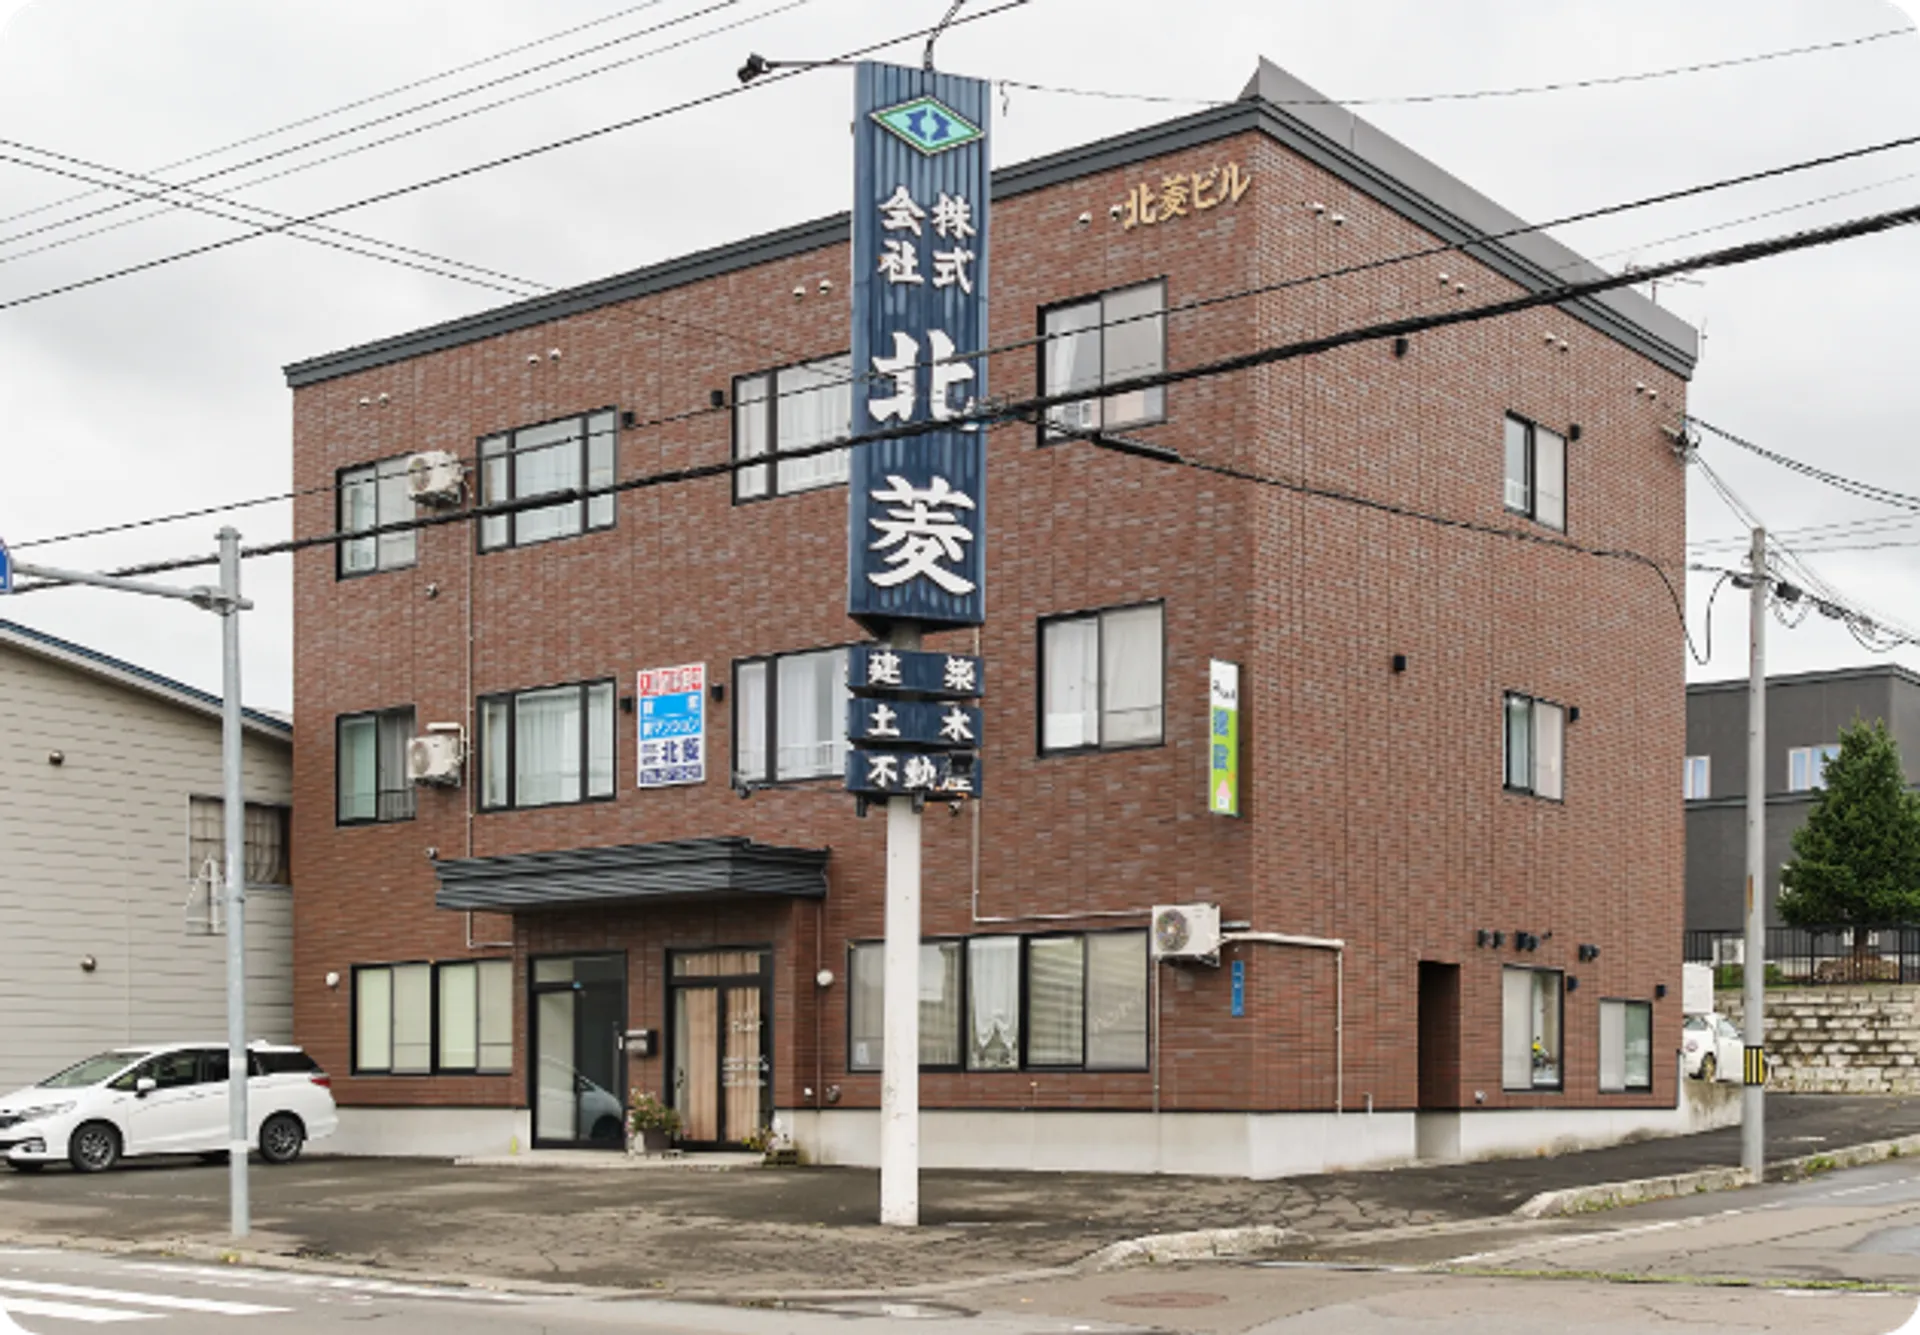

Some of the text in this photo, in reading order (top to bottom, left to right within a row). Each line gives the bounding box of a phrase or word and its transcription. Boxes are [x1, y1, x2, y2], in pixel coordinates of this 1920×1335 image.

[877, 184, 926, 285] 会社
[1123, 160, 1251, 230] 北菱ビル
[930, 191, 977, 294] 株式
[867, 328, 979, 596] 北菱
[867, 651, 975, 691] 建築
[866, 702, 975, 742] 土木
